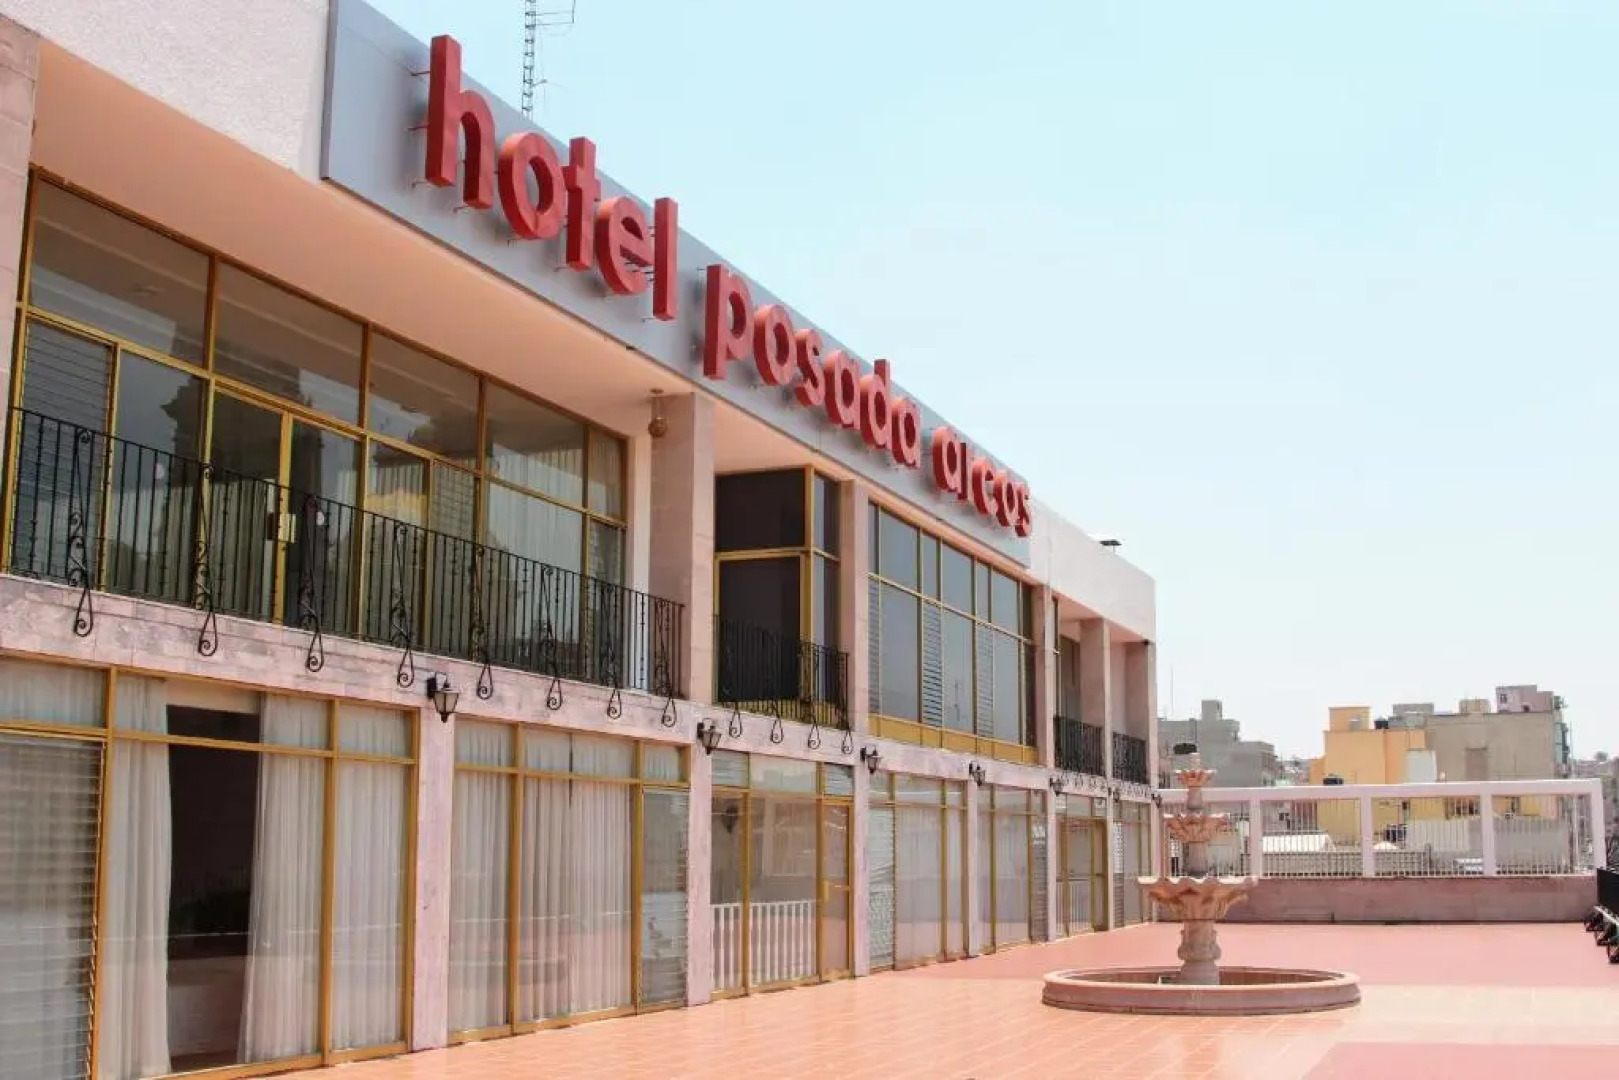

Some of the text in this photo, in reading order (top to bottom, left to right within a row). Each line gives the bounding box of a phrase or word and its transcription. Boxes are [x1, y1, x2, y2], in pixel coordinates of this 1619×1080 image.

[425, 34, 1031, 537] hotel posada arcos
